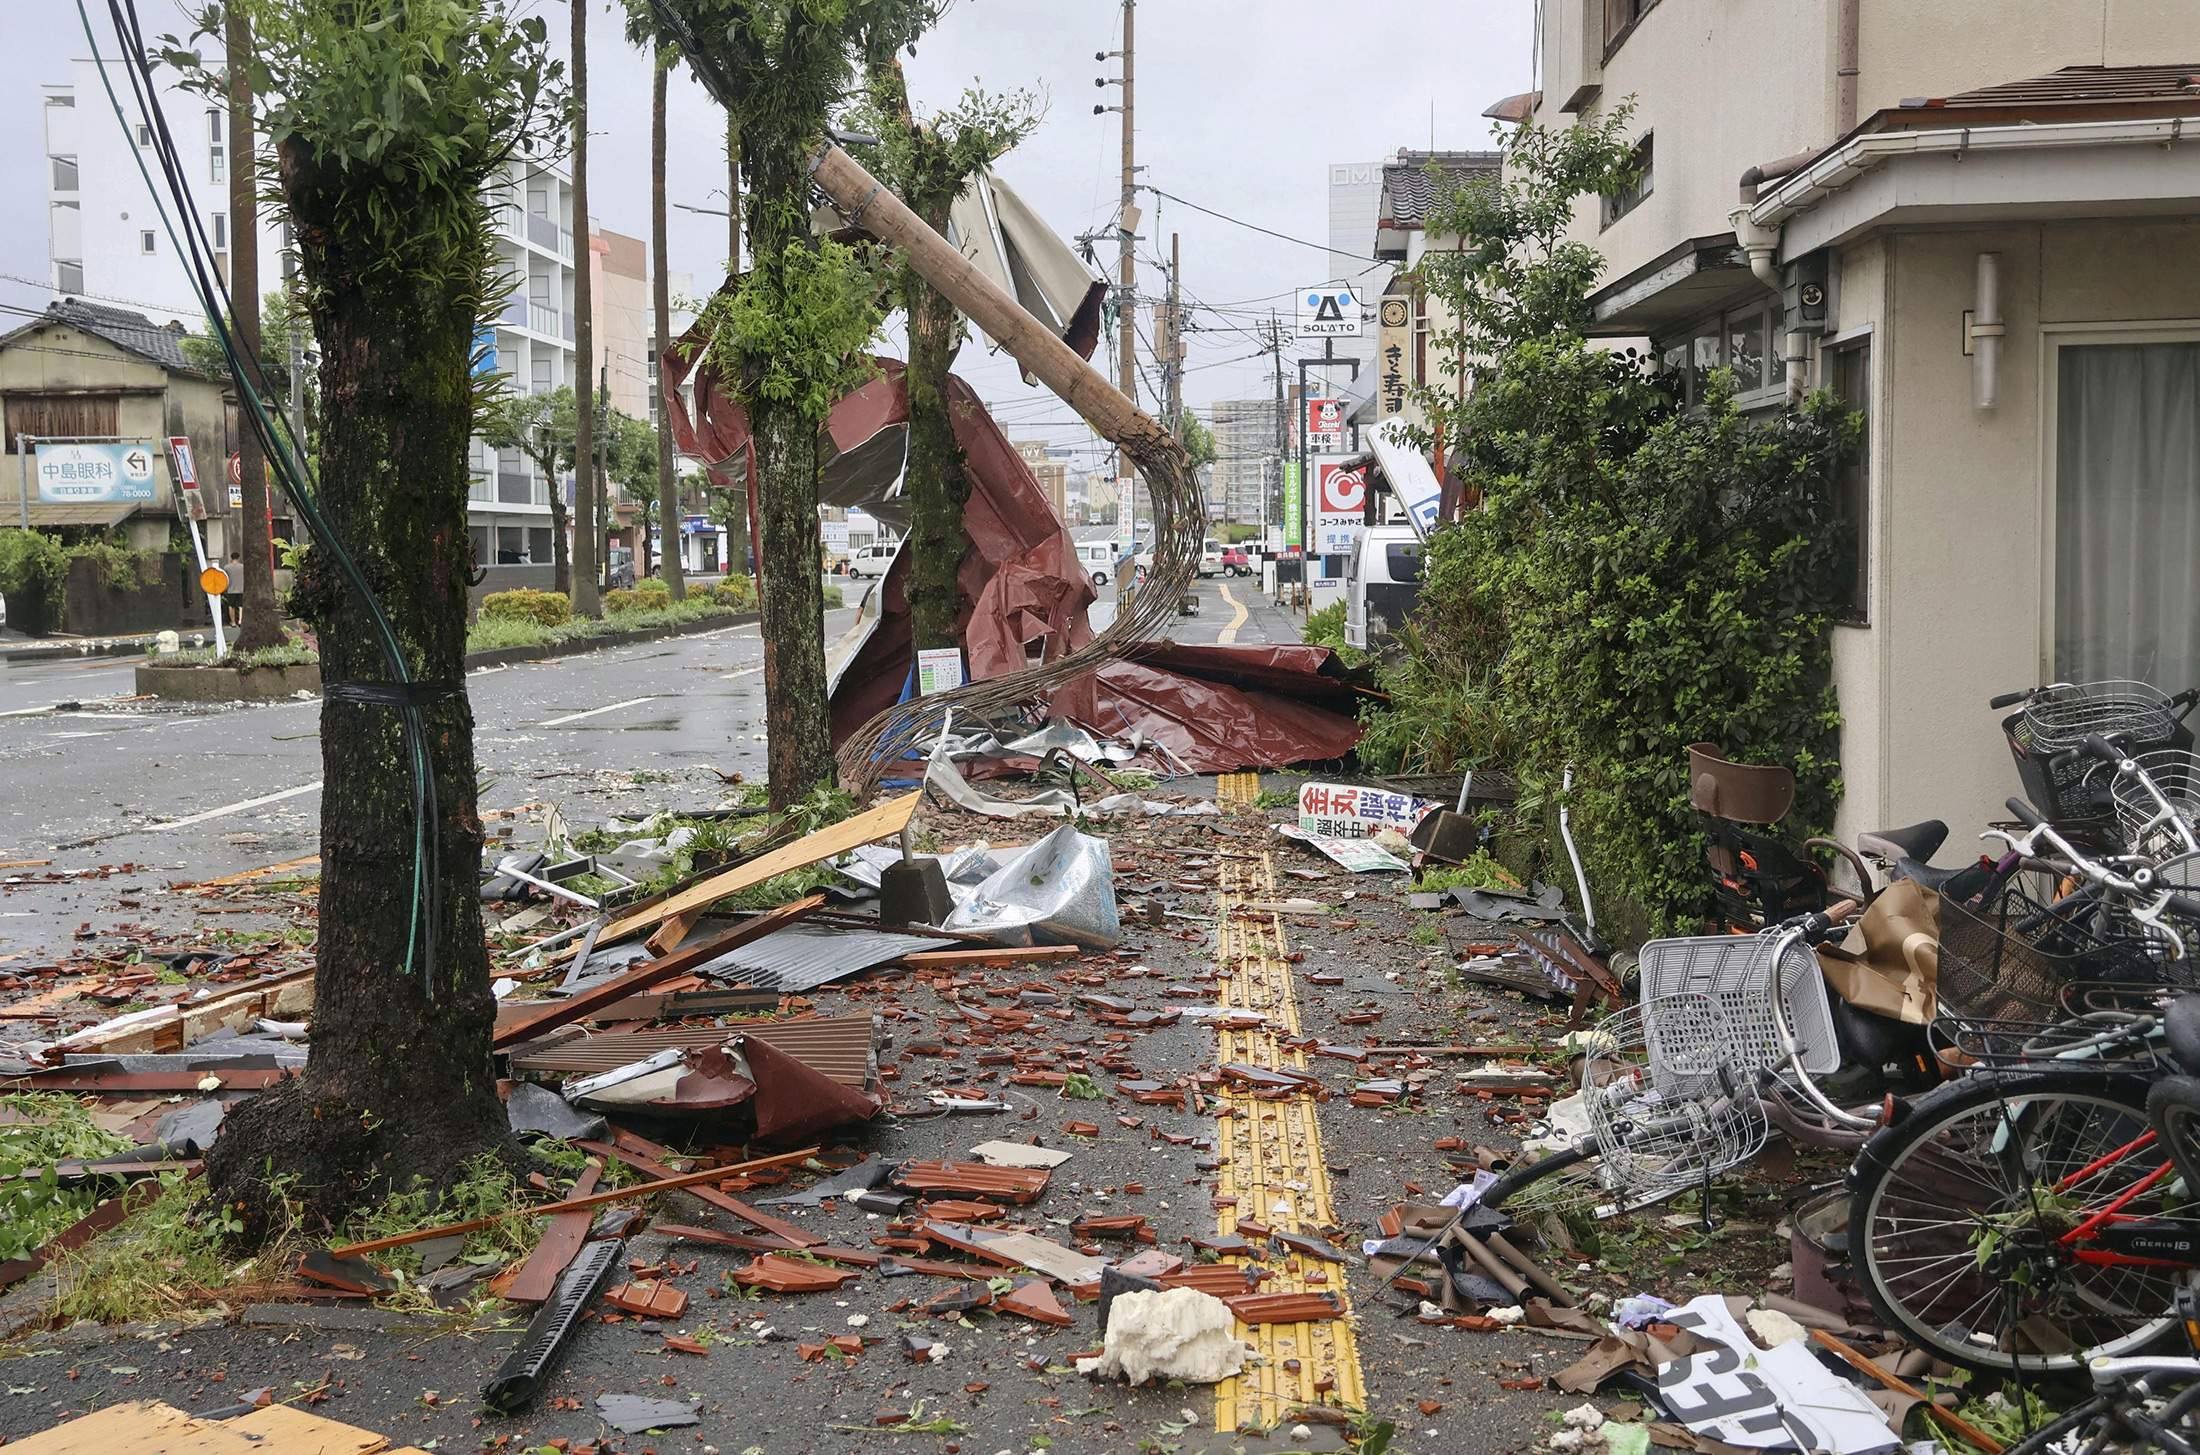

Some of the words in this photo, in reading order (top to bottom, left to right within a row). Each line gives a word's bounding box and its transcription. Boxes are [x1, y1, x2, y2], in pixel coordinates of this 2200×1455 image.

[1303, 323, 1355, 332] SOLATO
[1310, 433, 1331, 444] 車検
[1023, 448, 1040, 457] IVY
[43, 462, 113, 479] 中島眼科
[1288, 464, 1298, 538] エネルギア株式会社
